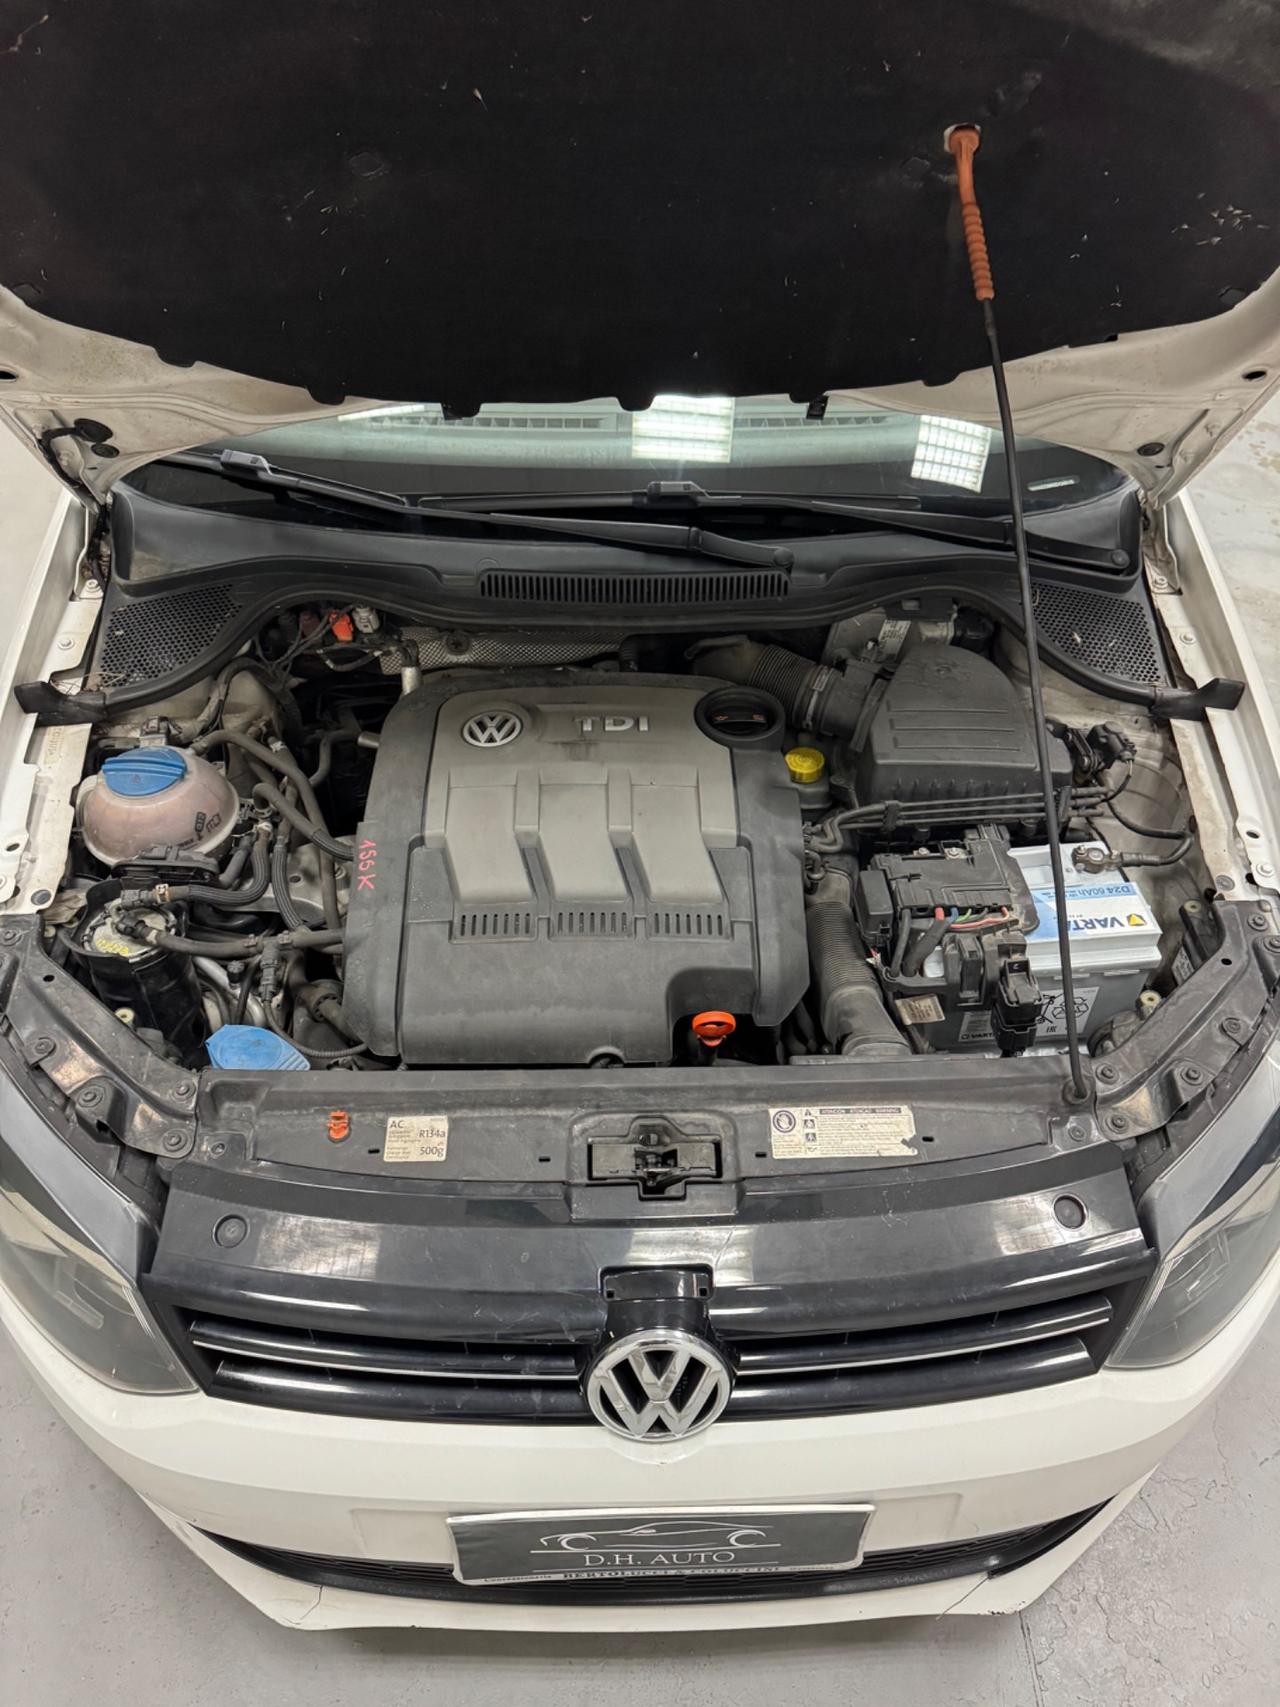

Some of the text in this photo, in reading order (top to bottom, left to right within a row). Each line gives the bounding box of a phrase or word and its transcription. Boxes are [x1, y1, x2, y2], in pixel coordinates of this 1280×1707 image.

[575, 715, 649, 732] TDI
[1067, 916, 1125, 931] VART
[390, 1120, 405, 1129] AC
[419, 1129, 446, 1138] R134a
[420, 1146, 444, 1157] 500g
[584, 1551, 735, 1566] D.H. AUTO
